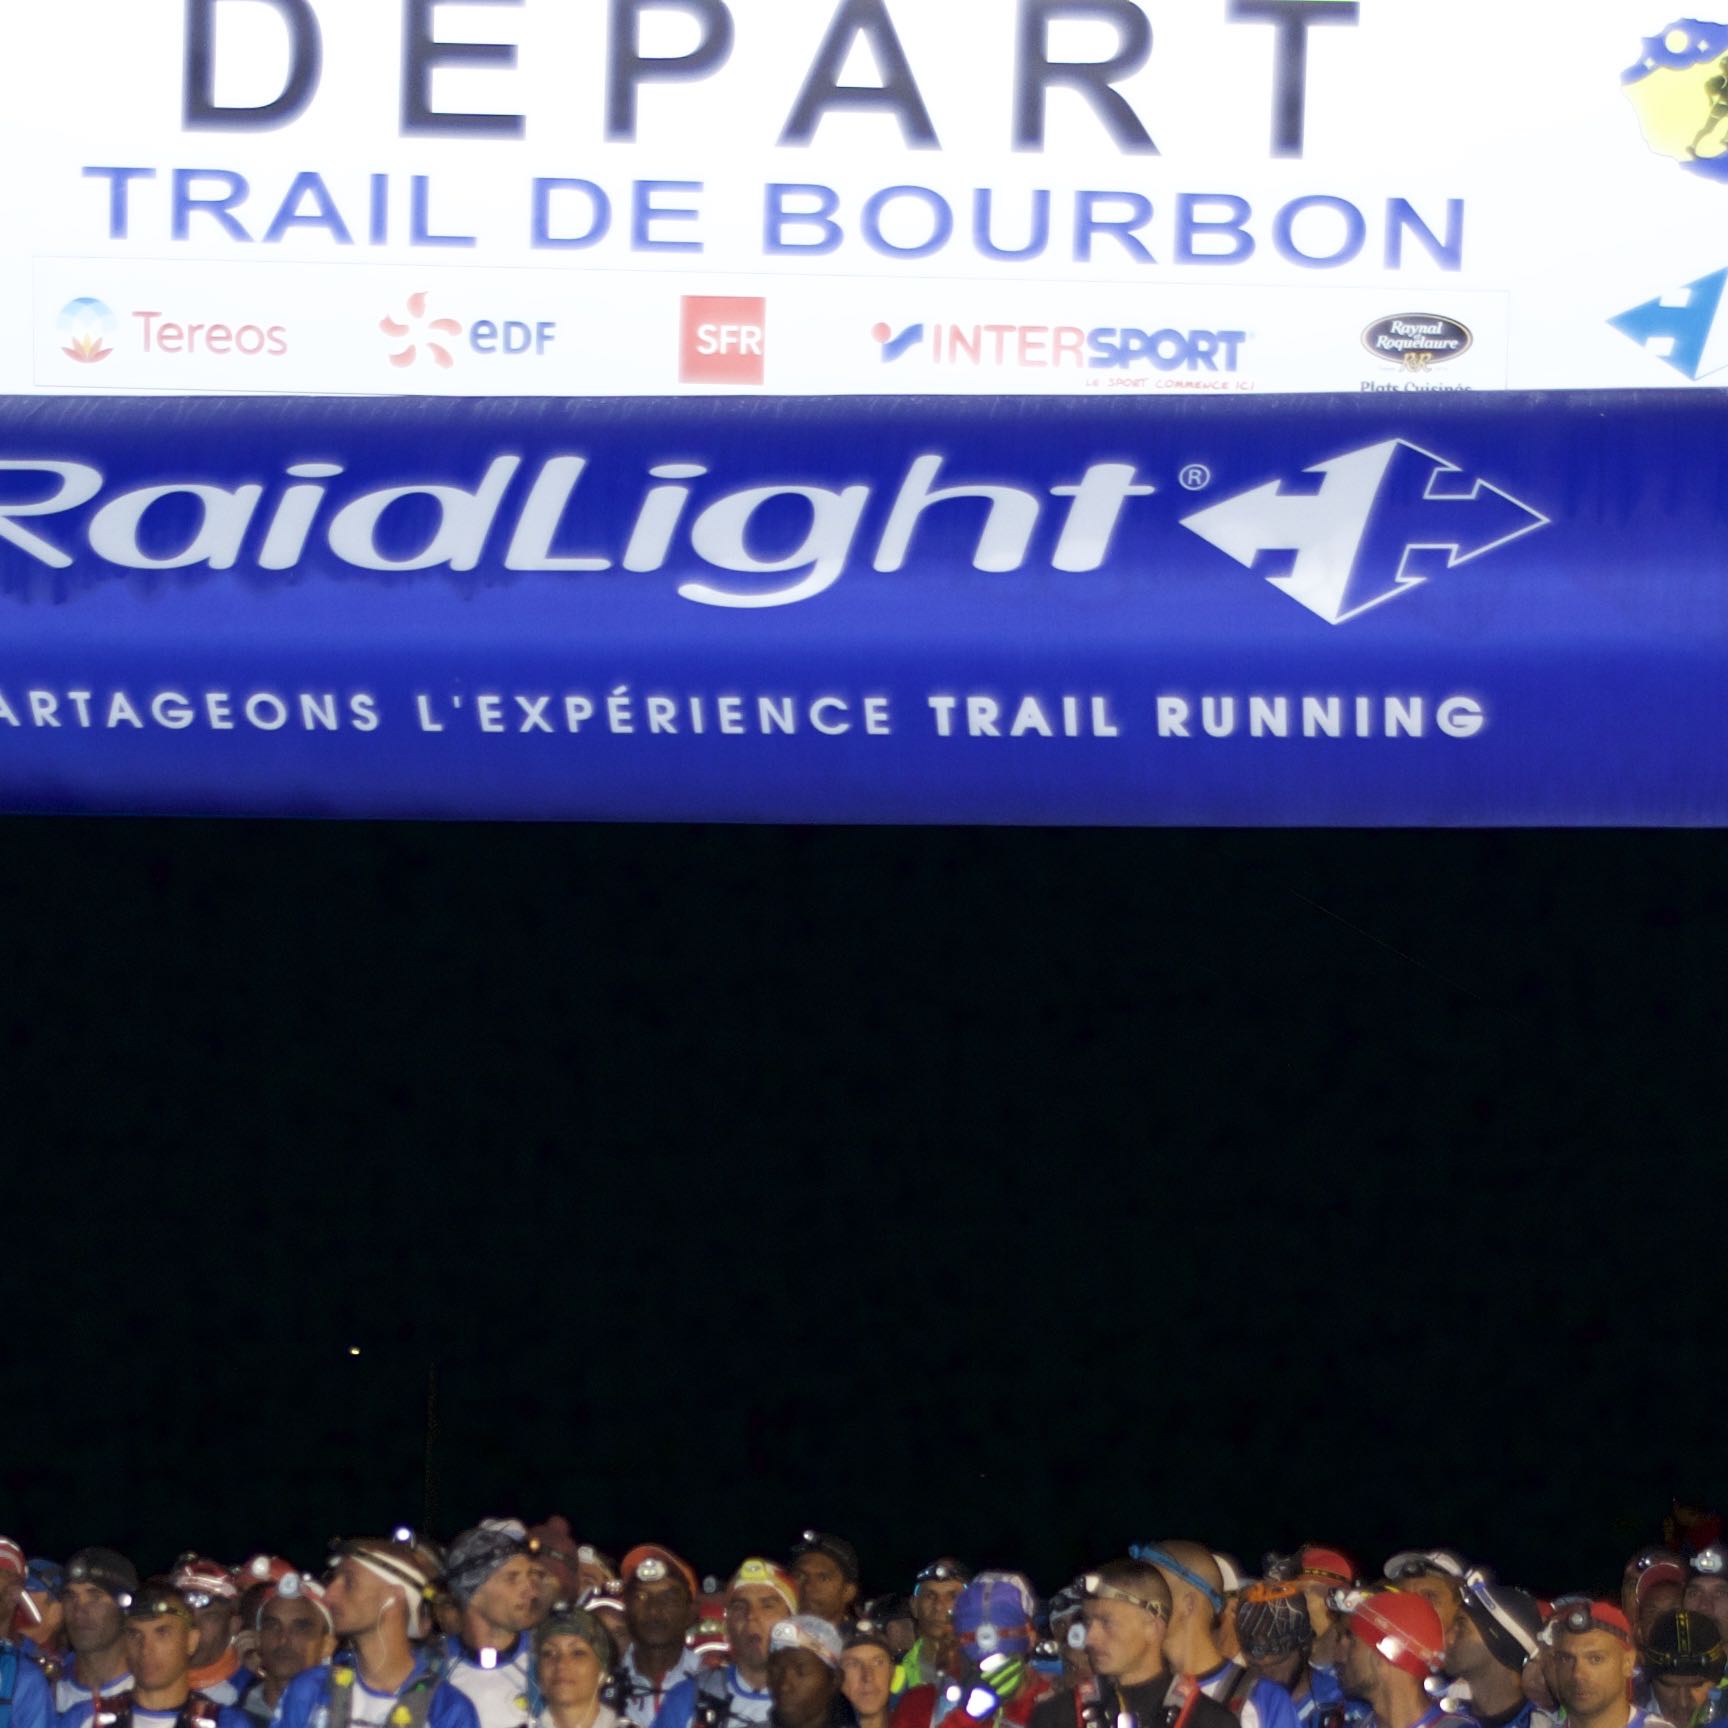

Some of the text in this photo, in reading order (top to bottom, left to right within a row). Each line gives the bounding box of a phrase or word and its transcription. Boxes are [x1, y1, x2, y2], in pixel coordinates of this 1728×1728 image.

[180, 0, 1360, 158] DEPART
[80, 166, 1467, 272] TRAIL DE BOURBON
[132, 311, 289, 356] Tereos
[696, 323, 764, 355] SFR
[933, 323, 1247, 372] INTERSPORT
[1376, 335, 1460, 352] Roquelaure
[1390, 320, 1444, 338] Raynal
[1085, 378, 1256, 392] LE SPORT COMMENCE ICI
[419, 684, 891, 736] L'EXPÉRIENCE
[929, 695, 1120, 738] TRAIL
[1157, 695, 1487, 739] RUNNING
